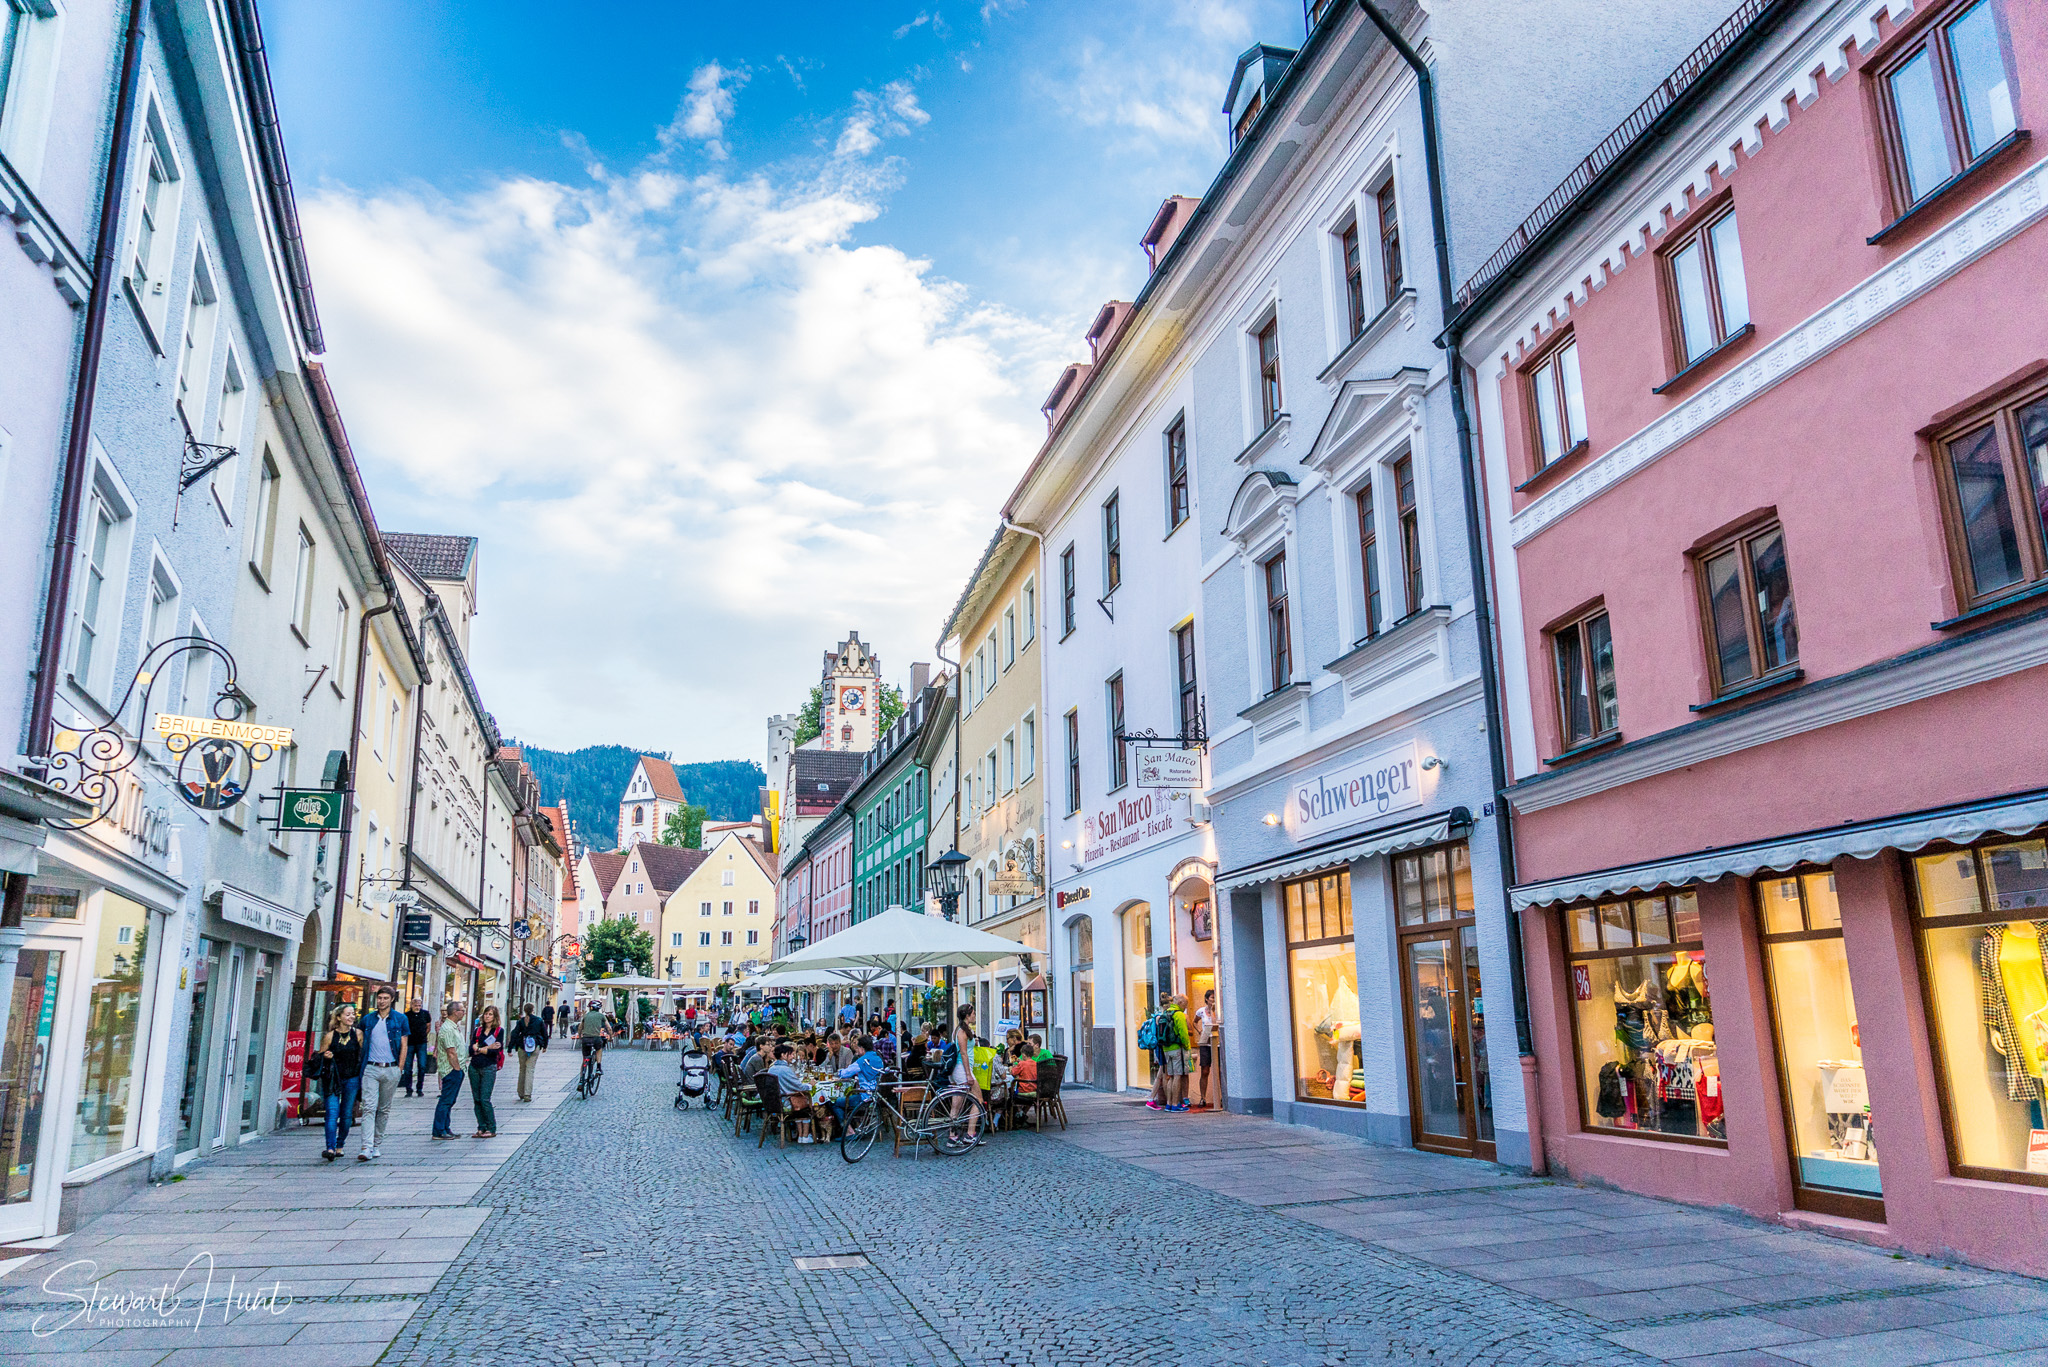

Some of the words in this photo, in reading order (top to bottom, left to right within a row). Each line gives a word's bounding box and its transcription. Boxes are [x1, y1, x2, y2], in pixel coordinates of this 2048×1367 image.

[159, 716, 287, 743] BRILLENMODE
[1144, 755, 1162, 766] San
[1164, 752, 1196, 766] Marco
[296, 797, 322, 814] dolce
[1298, 759, 1413, 824] Schwenger
[1098, 810, 1117, 840] San
[1118, 794, 1151, 831] Marco
[1084, 843, 1104, 863] Pizzeria
[1110, 828, 1140, 852] Restaurant
[1147, 814, 1173, 838] Eiscafe
[1063, 888, 1079, 905] Street
[1078, 886, 1091, 900] One
[241, 905, 262, 926] ITALIAN
[275, 918, 292, 935] COFFEE
